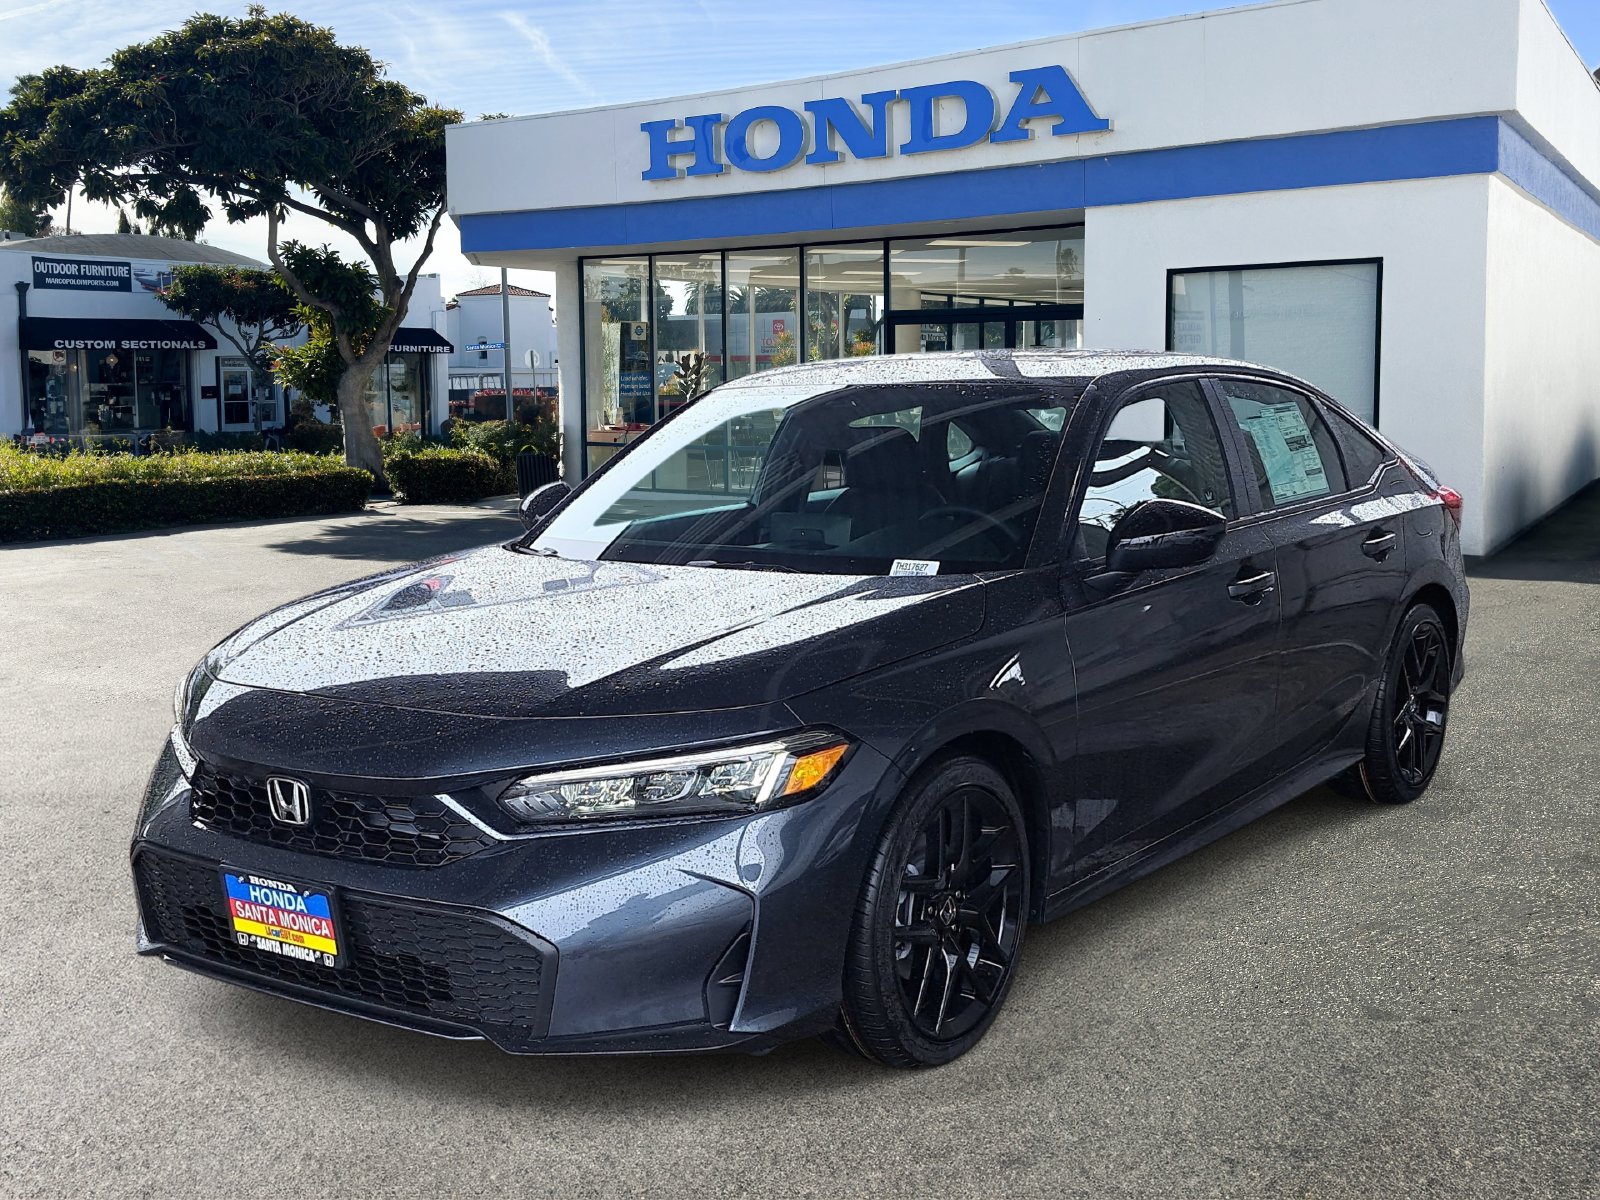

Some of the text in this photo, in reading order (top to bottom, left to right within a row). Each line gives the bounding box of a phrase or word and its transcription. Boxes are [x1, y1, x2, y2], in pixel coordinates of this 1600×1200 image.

[641, 65, 1114, 181] HONDA
[34, 261, 130, 278] OUTDOOR FURNITURE
[45, 277, 120, 287] MARCOPOLOIMPORTS.COM
[54, 339, 206, 349] CUSTOM SECTIONALS
[388, 344, 451, 353] FURNITURE
[248, 875, 298, 893] HONDA
[249, 885, 308, 914] HONDA
[235, 900, 331, 938] SANTA MONICA
[256, 936, 316, 963] SANTA MONICA
